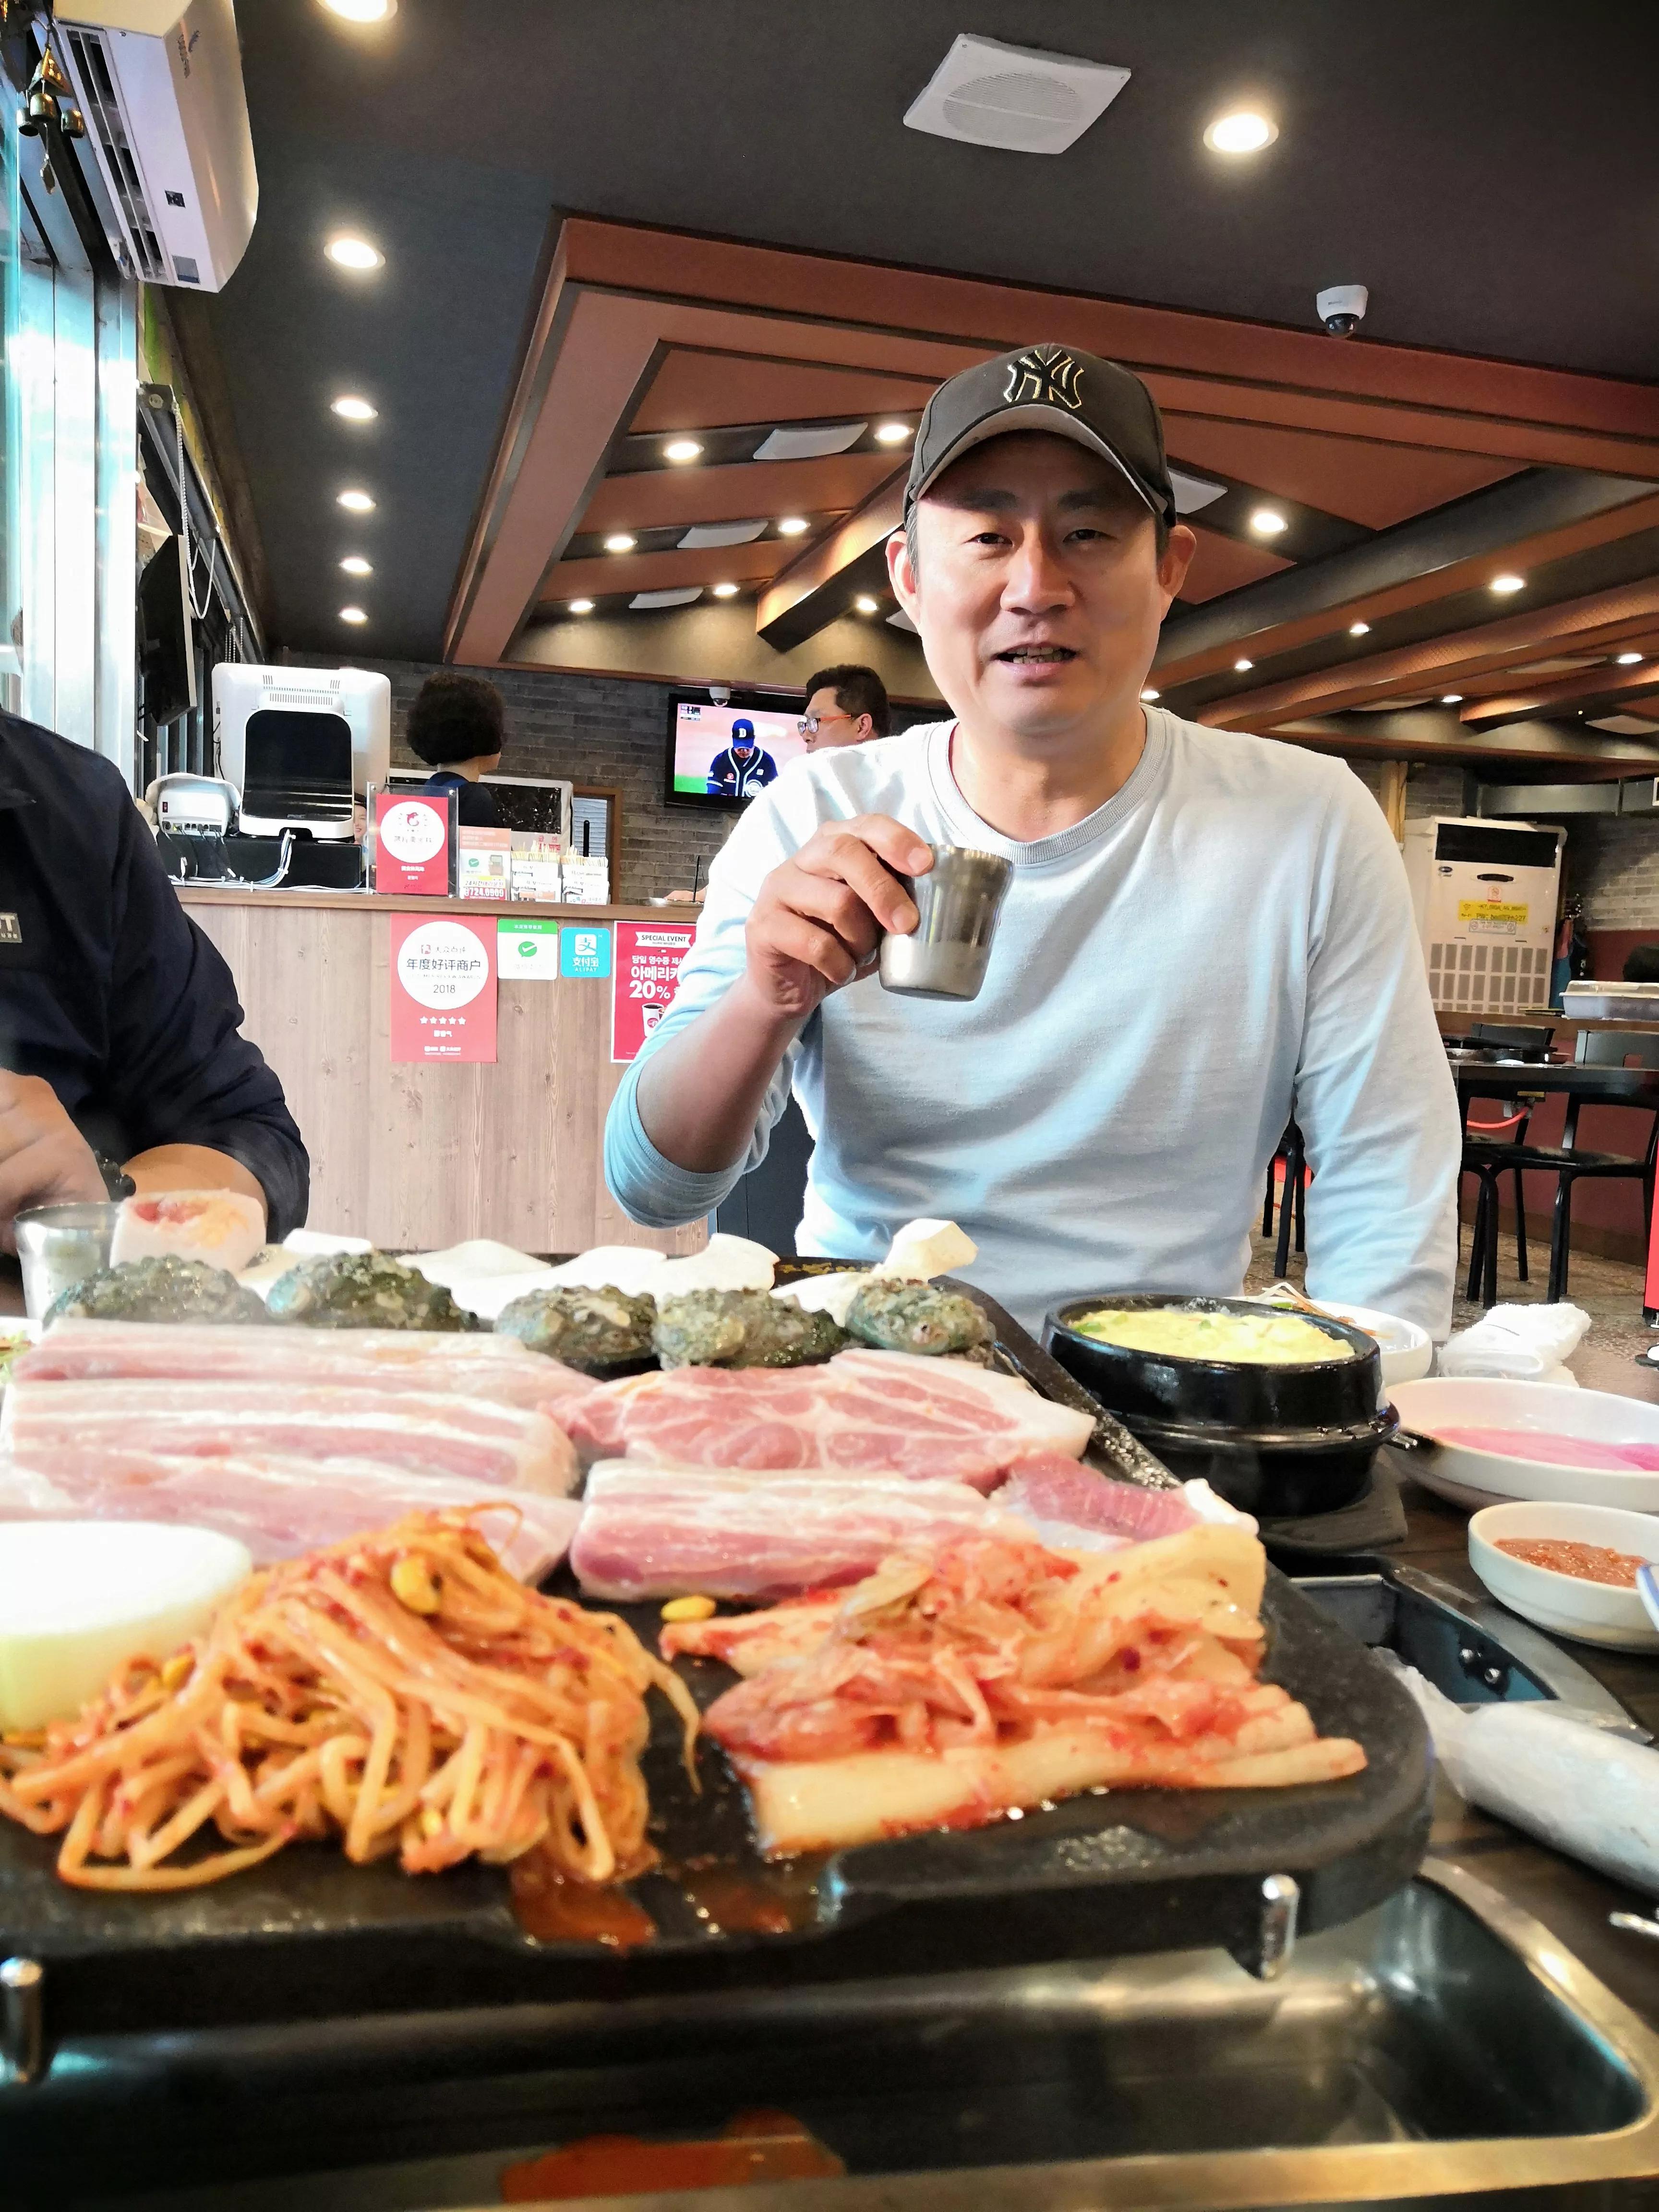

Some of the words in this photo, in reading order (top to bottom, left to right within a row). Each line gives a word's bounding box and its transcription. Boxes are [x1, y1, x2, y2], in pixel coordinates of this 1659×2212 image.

[1003, 349, 1084, 409] NY
[739, 728, 746, 737] D
[407, 959, 481, 971] 年度好评商户
[572, 957, 599, 967] 支付宝
[632, 955, 647, 964] 당일
[649, 956, 670, 965] 영수증
[433, 985, 456, 993] 2018
[629, 980, 671, 999] 20%
